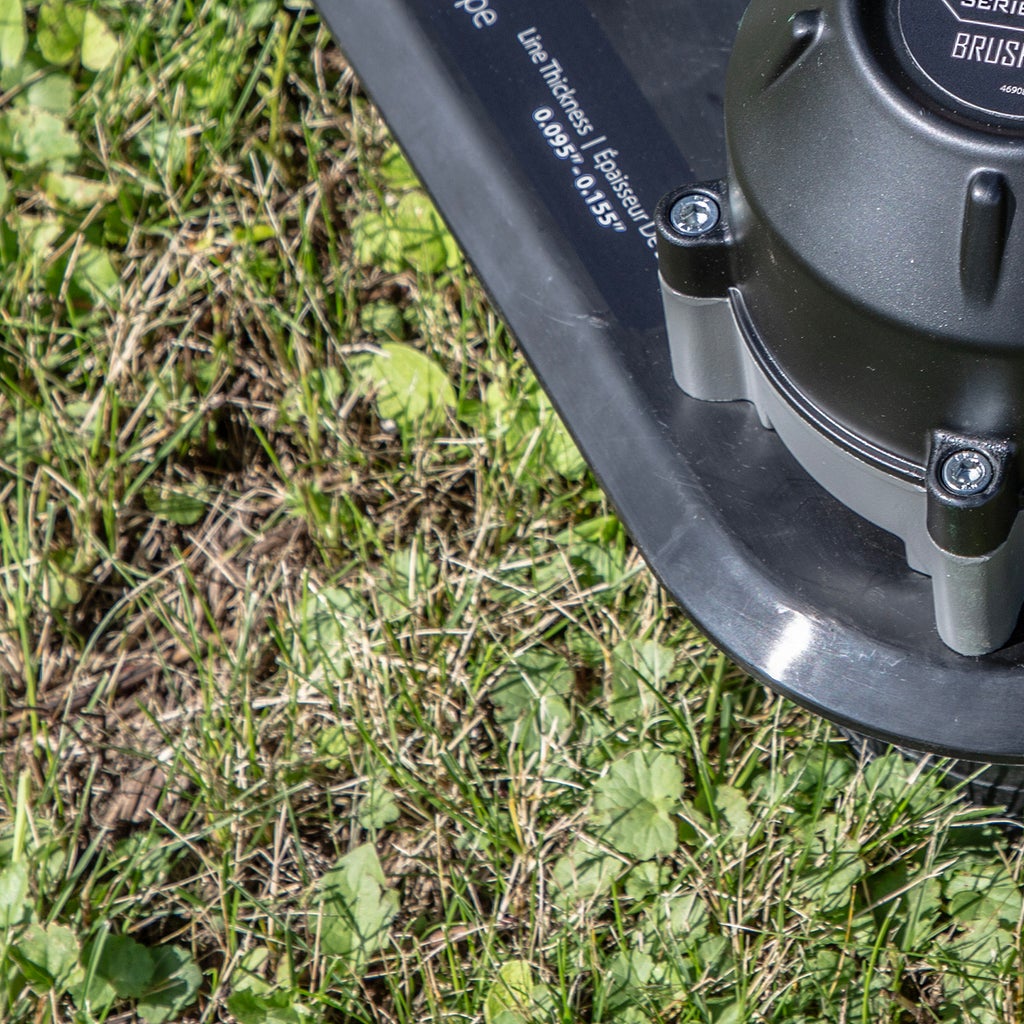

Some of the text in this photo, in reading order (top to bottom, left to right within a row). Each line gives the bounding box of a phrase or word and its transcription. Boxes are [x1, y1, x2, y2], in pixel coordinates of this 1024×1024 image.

[517, 26, 548, 64] Line
[539, 57, 594, 136] Thickness
[593, 147, 649, 222] Épaisseur
